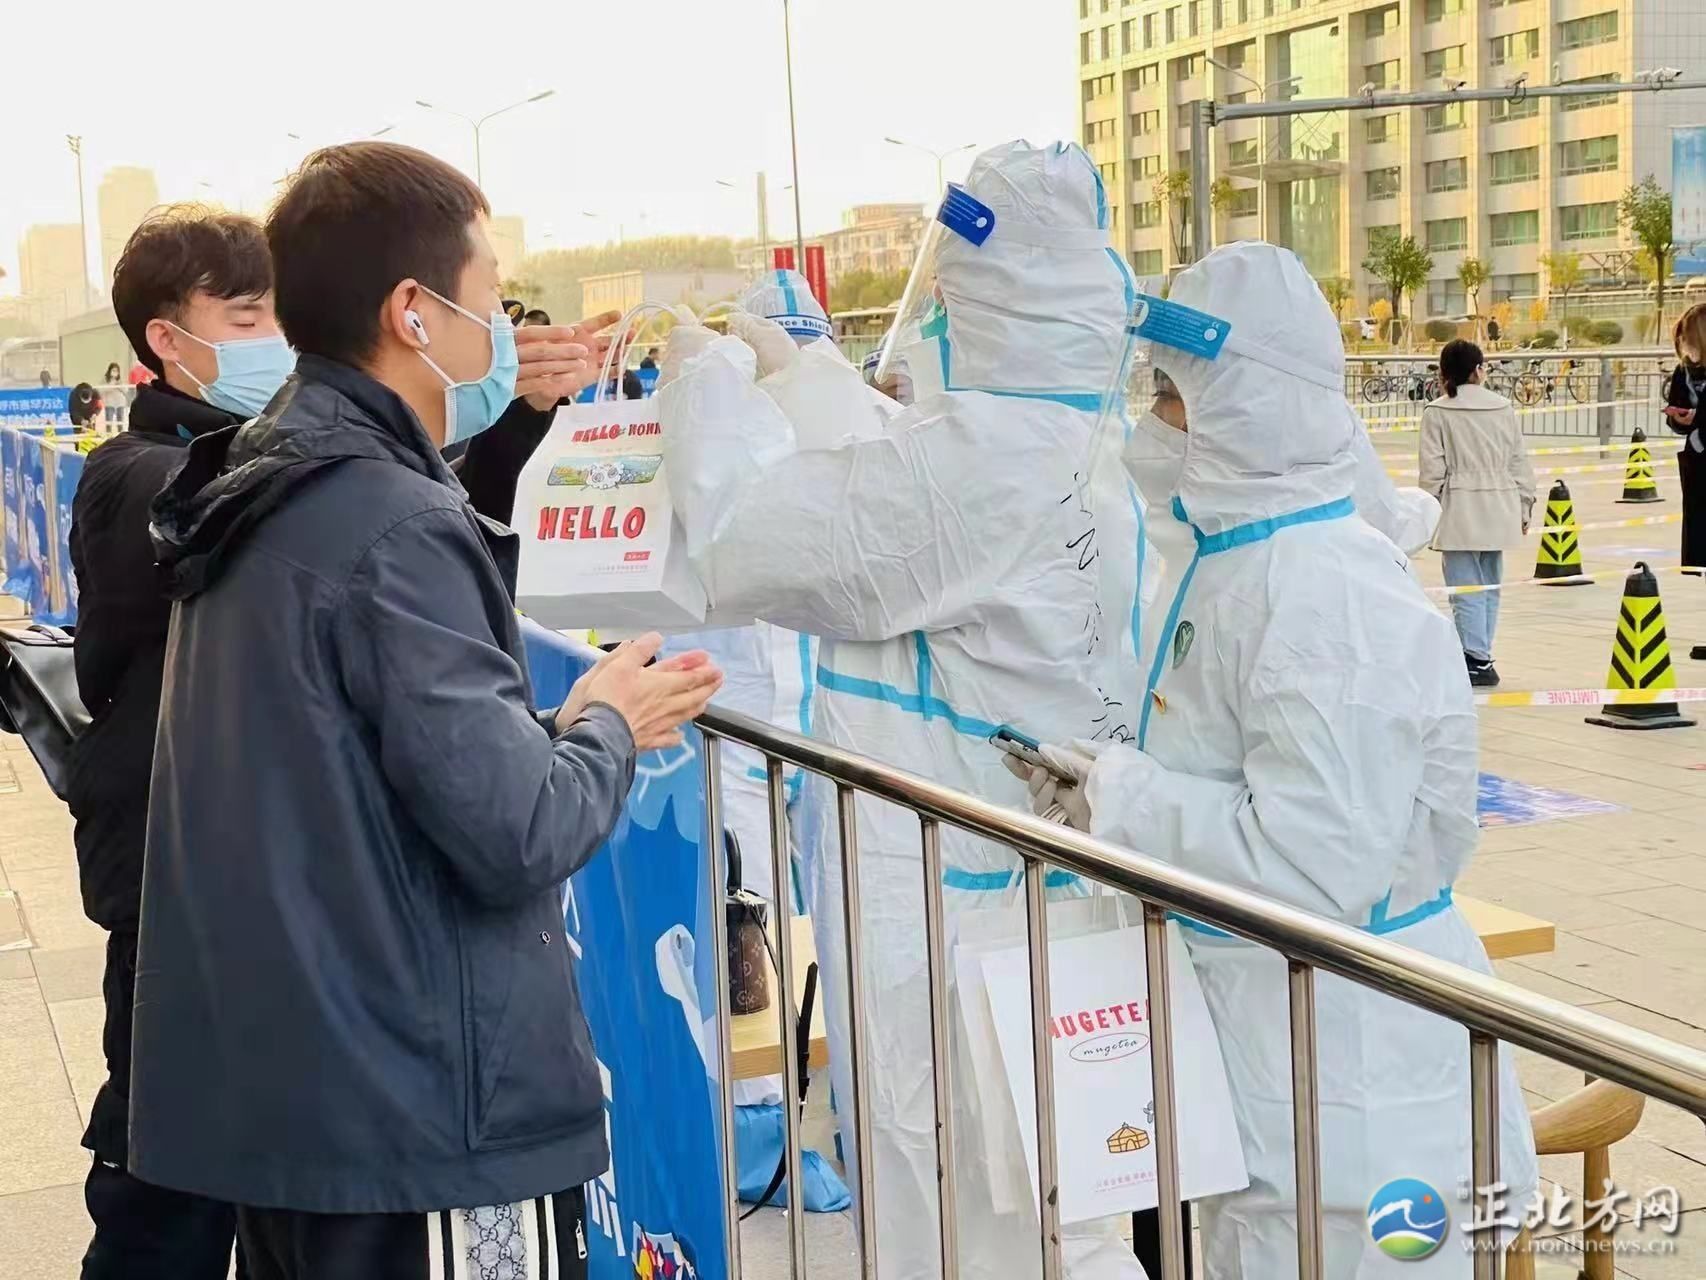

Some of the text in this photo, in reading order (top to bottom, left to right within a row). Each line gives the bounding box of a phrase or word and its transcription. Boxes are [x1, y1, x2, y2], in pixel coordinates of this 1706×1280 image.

[802, 319, 830, 333] Shield
[571, 423, 620, 442] HELLO
[537, 505, 646, 540] HELLO
[1083, 1038, 1138, 1056] mugetea
